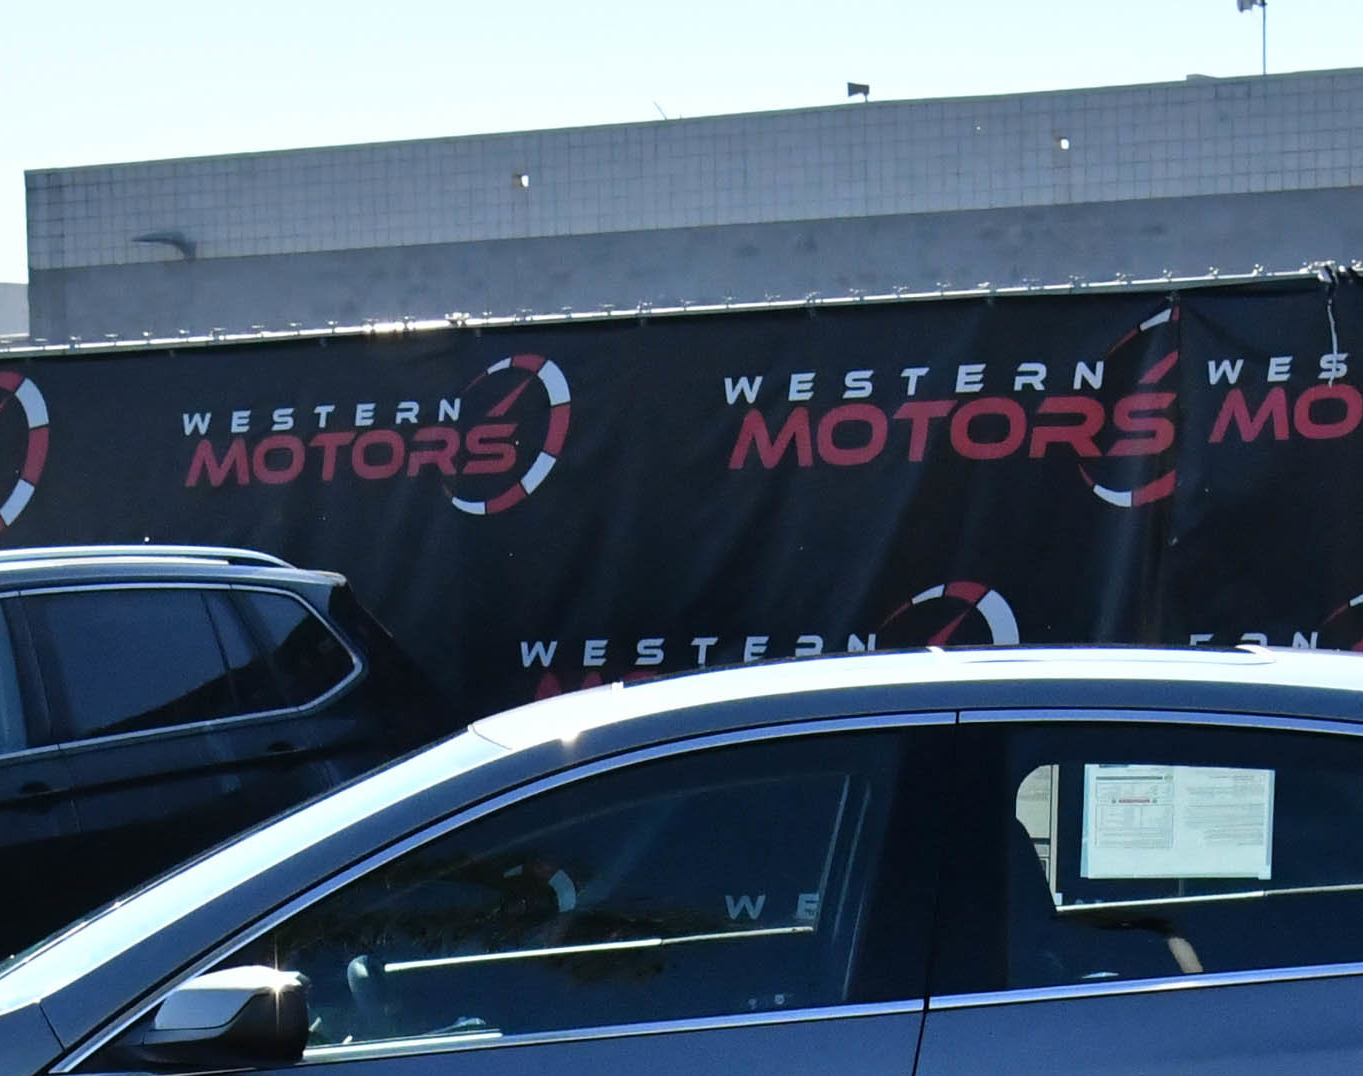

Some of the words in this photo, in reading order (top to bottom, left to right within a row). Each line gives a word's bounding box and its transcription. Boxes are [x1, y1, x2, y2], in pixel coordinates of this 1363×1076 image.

[724, 360, 1105, 405] WESTERN
[182, 398, 462, 434] WESTERN
[726, 392, 1178, 471] MOTORS
[184, 424, 520, 487] MOTORS
